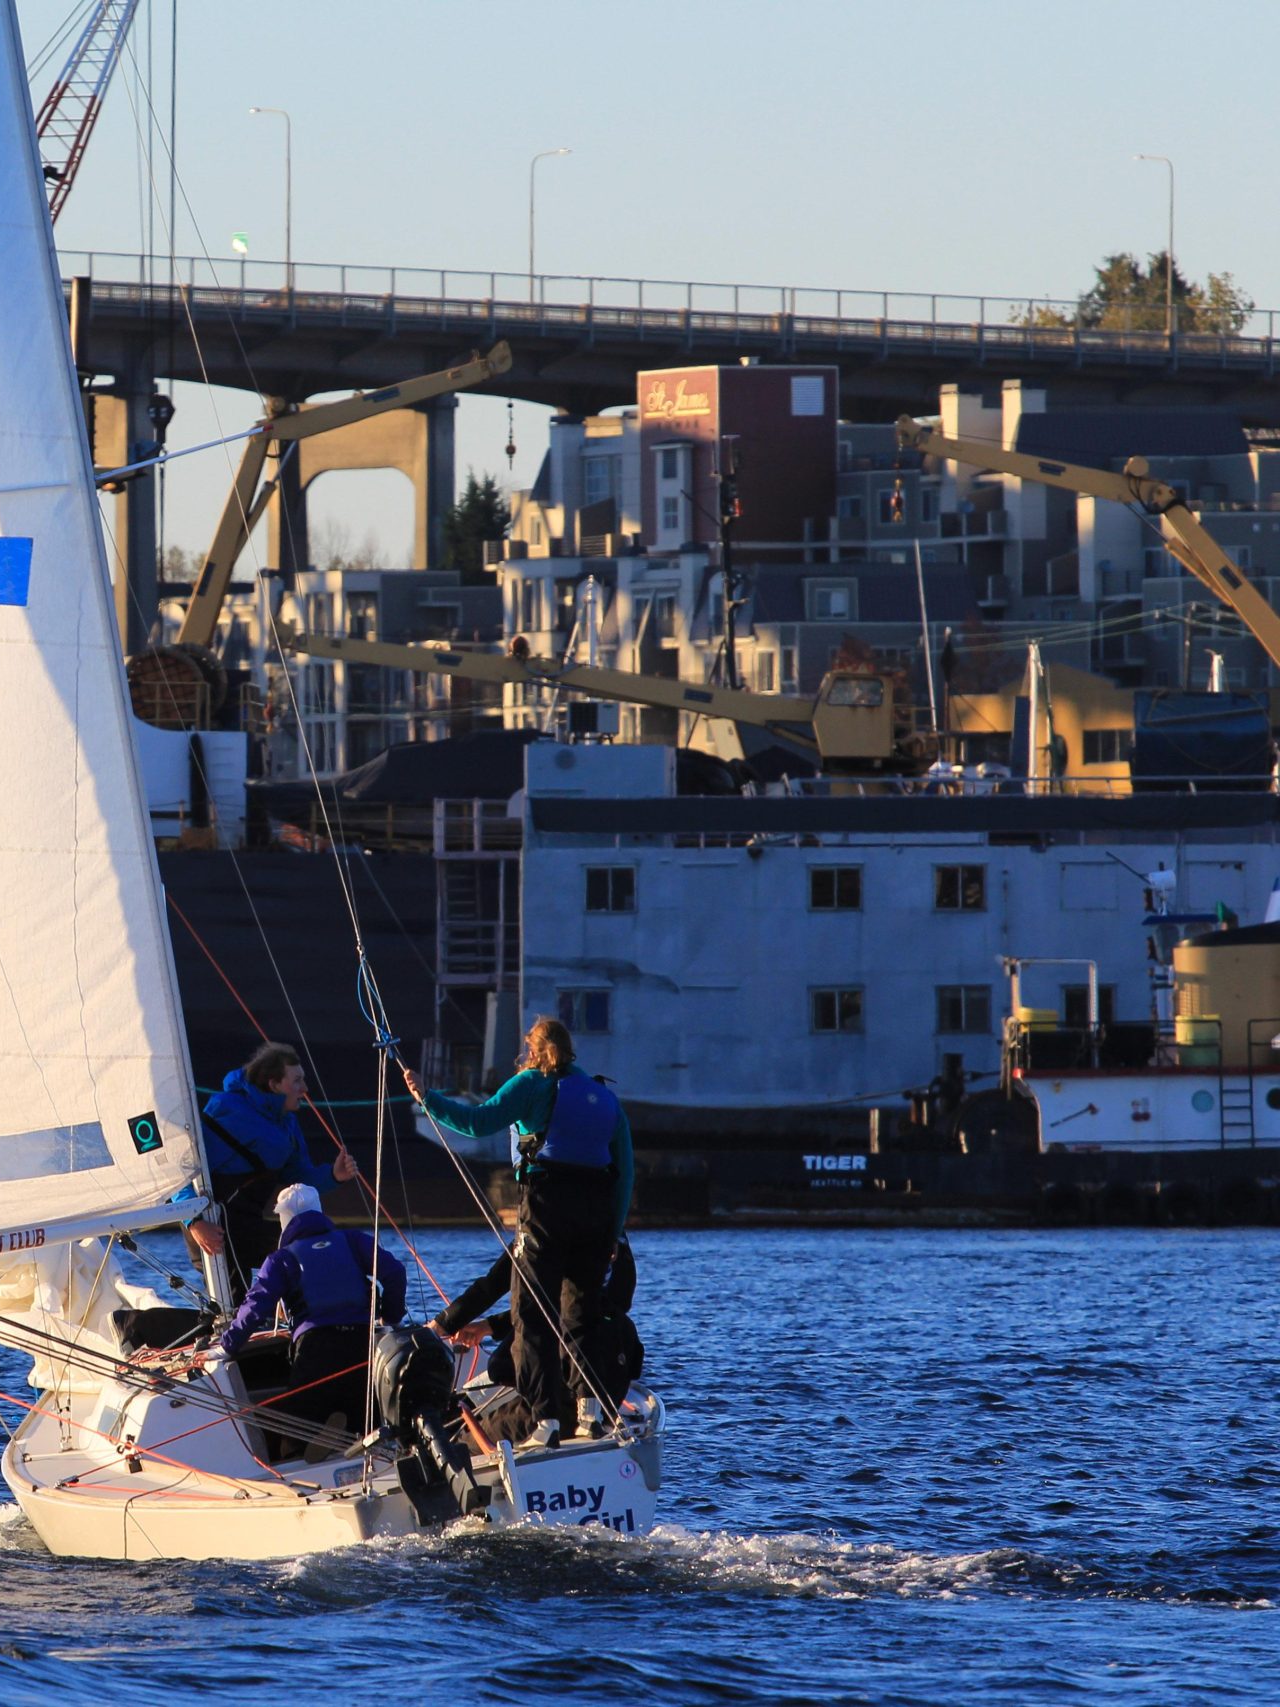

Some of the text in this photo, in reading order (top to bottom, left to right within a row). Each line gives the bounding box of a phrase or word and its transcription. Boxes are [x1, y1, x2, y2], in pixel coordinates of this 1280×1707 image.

[803, 1155, 867, 1170] TIGER
[9, 1228, 46, 1251] CLUB
[525, 1484, 606, 1513] Baby
